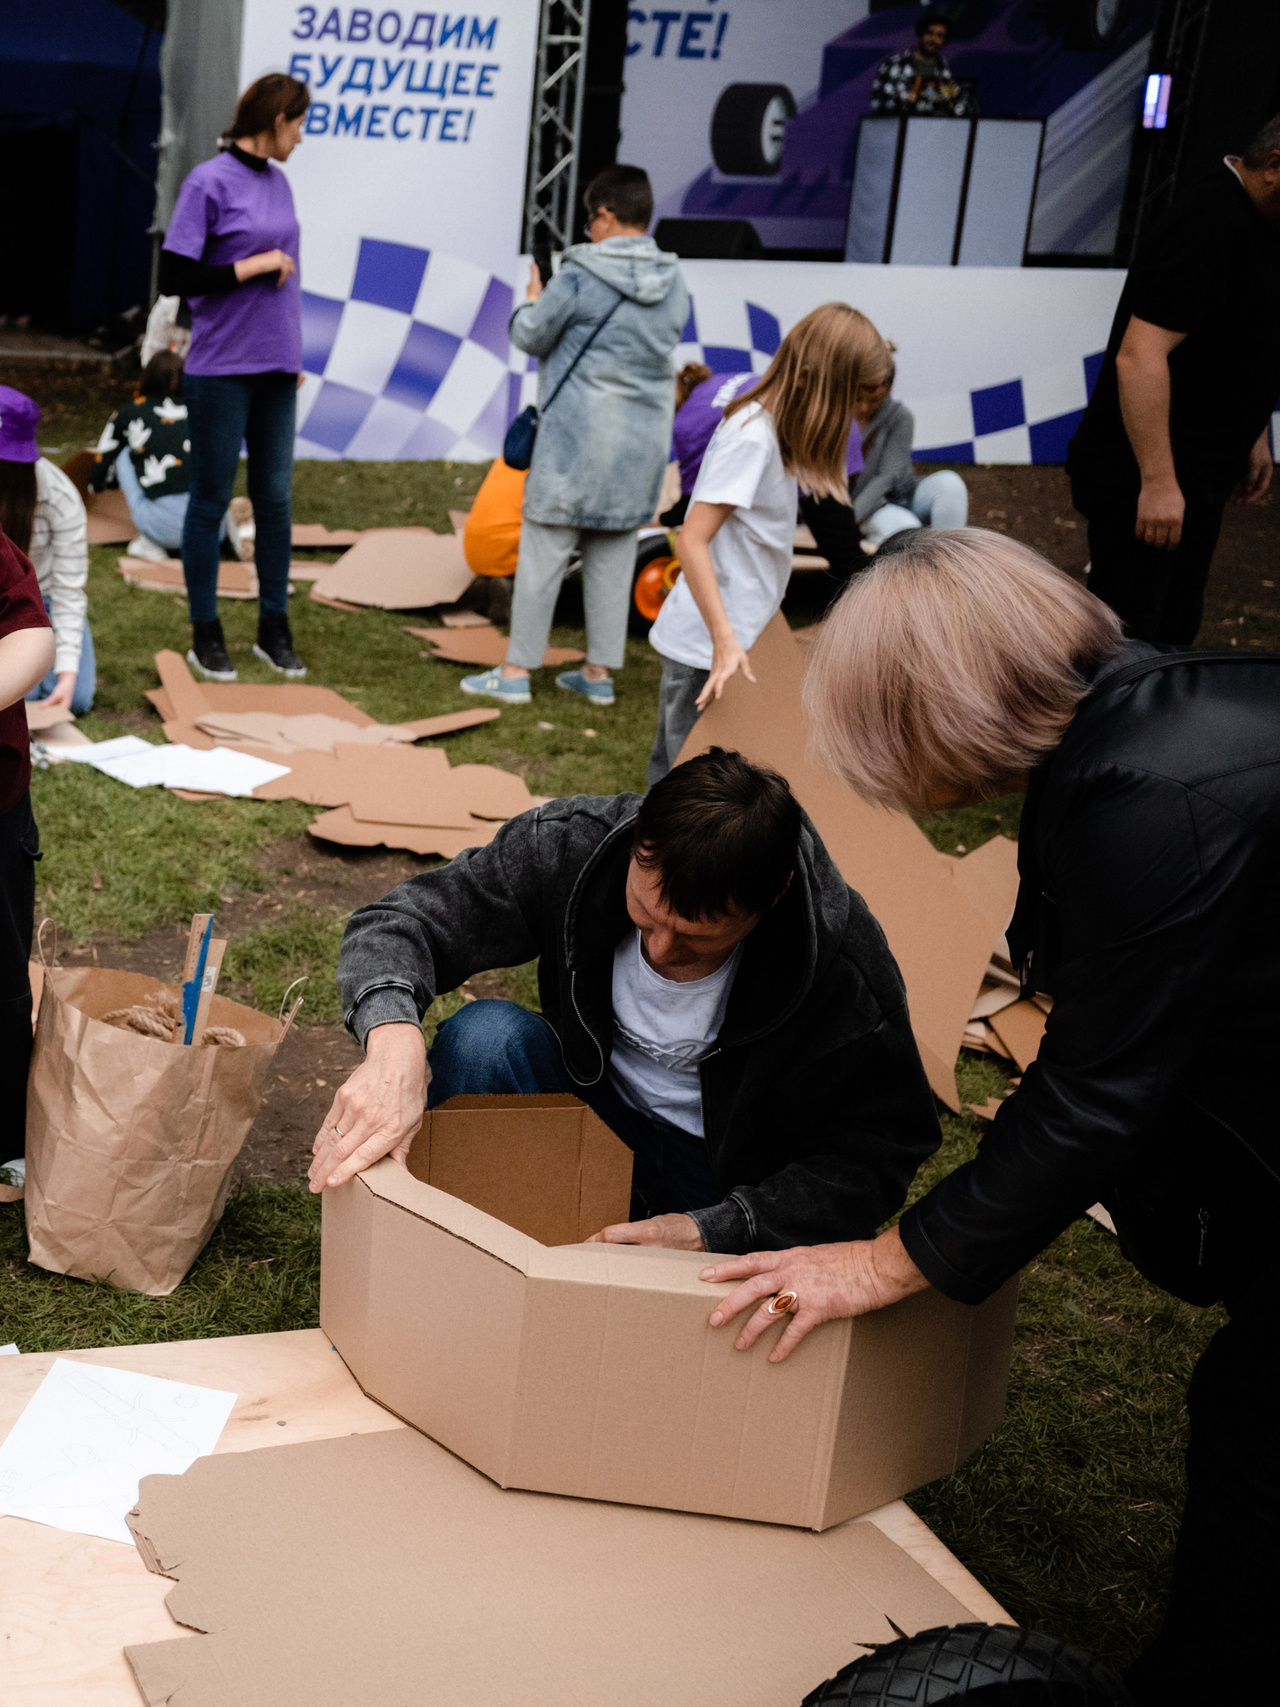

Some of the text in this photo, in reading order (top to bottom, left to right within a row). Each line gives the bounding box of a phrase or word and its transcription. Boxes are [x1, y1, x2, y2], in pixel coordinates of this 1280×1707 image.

[292, 5, 499, 51] ЗАВОДИМ
[289, 53, 500, 99] БУДУЩЕЕ
[305, 102, 475, 142] ВМЕСТЕ!
